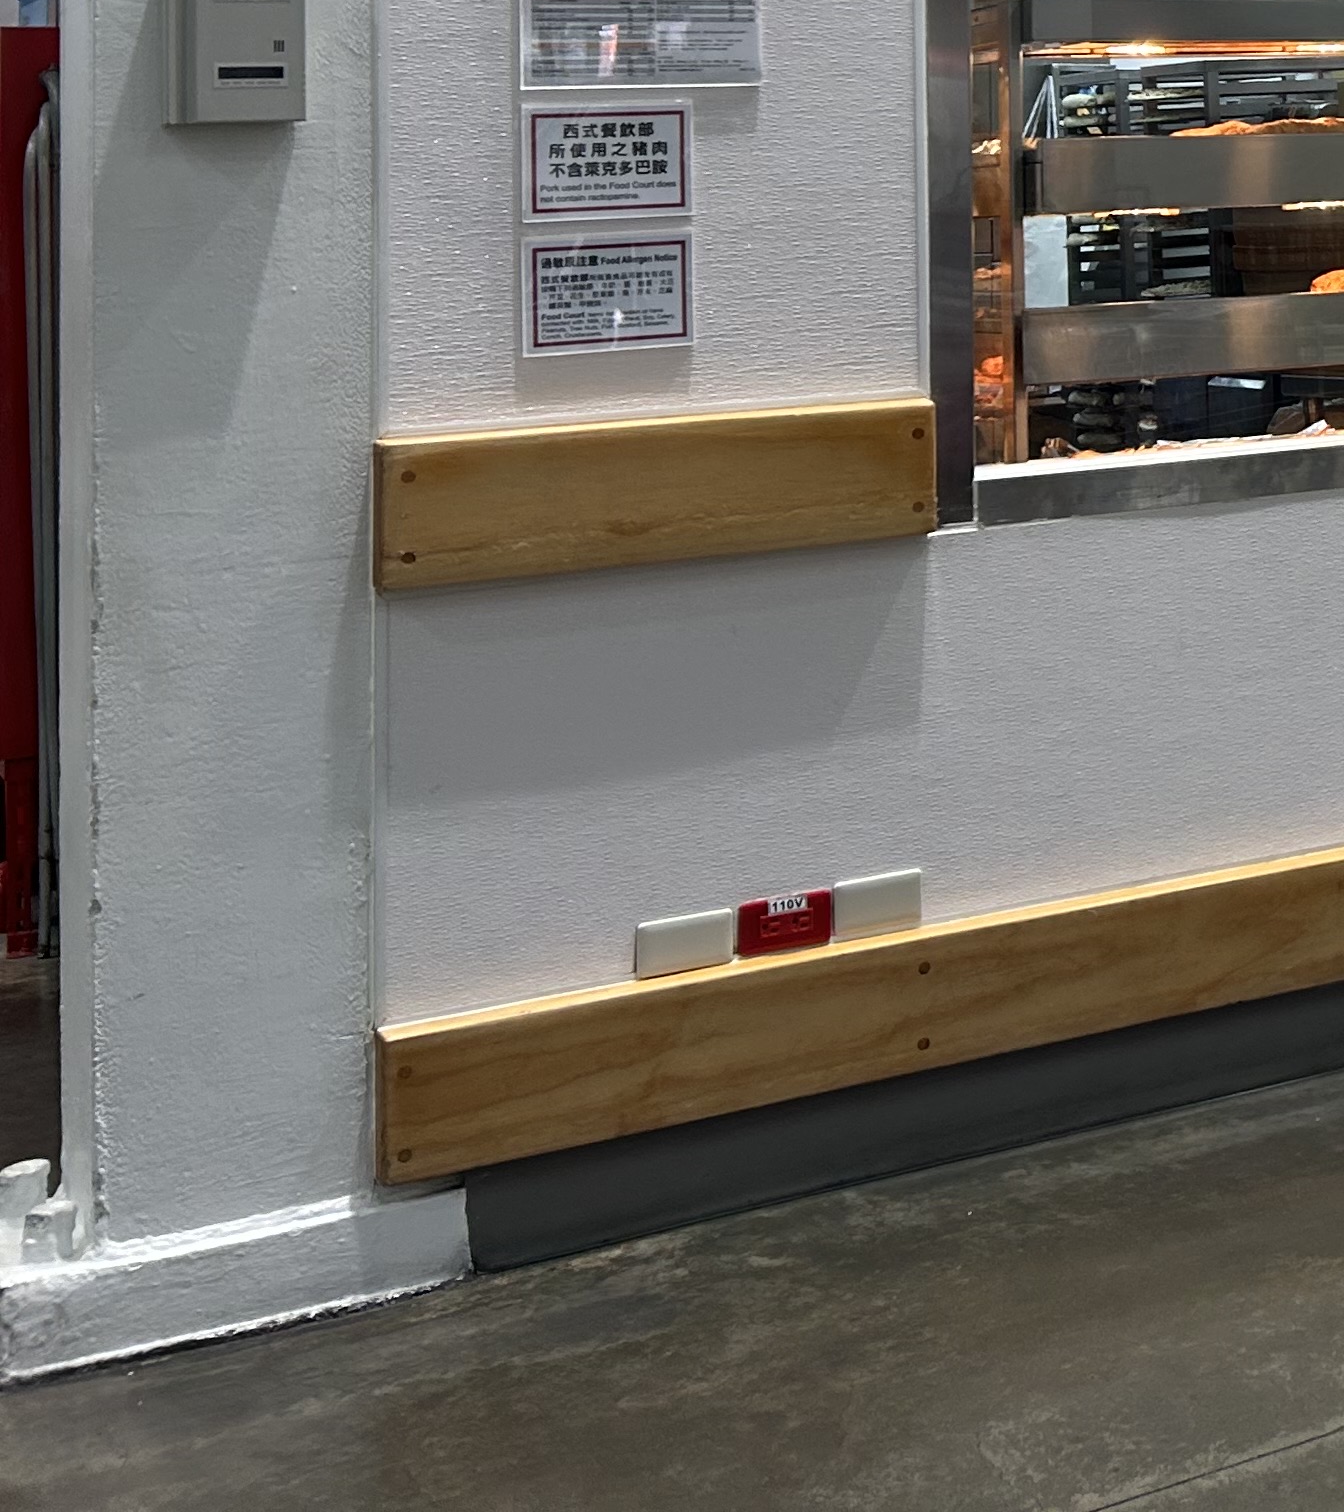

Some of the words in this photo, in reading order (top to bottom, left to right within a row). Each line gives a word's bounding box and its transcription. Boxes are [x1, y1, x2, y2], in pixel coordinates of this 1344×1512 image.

[562, 122, 655, 139] 西式餐飲部
[548, 141, 668, 159] 所使用之豬肉
[549, 159, 668, 178] 不含萊克多巴胺
[540, 184, 559, 193] Pork
[561, 184, 581, 192] used
[584, 183, 592, 191] in
[593, 182, 607, 191] the
[609, 182, 630, 190] Food
[632, 181, 655, 189] Court
[656, 180, 677, 188] does
[554, 193, 586, 202] contain
[600, 256, 620, 265] Food
[772, 897, 804, 913] 110V
